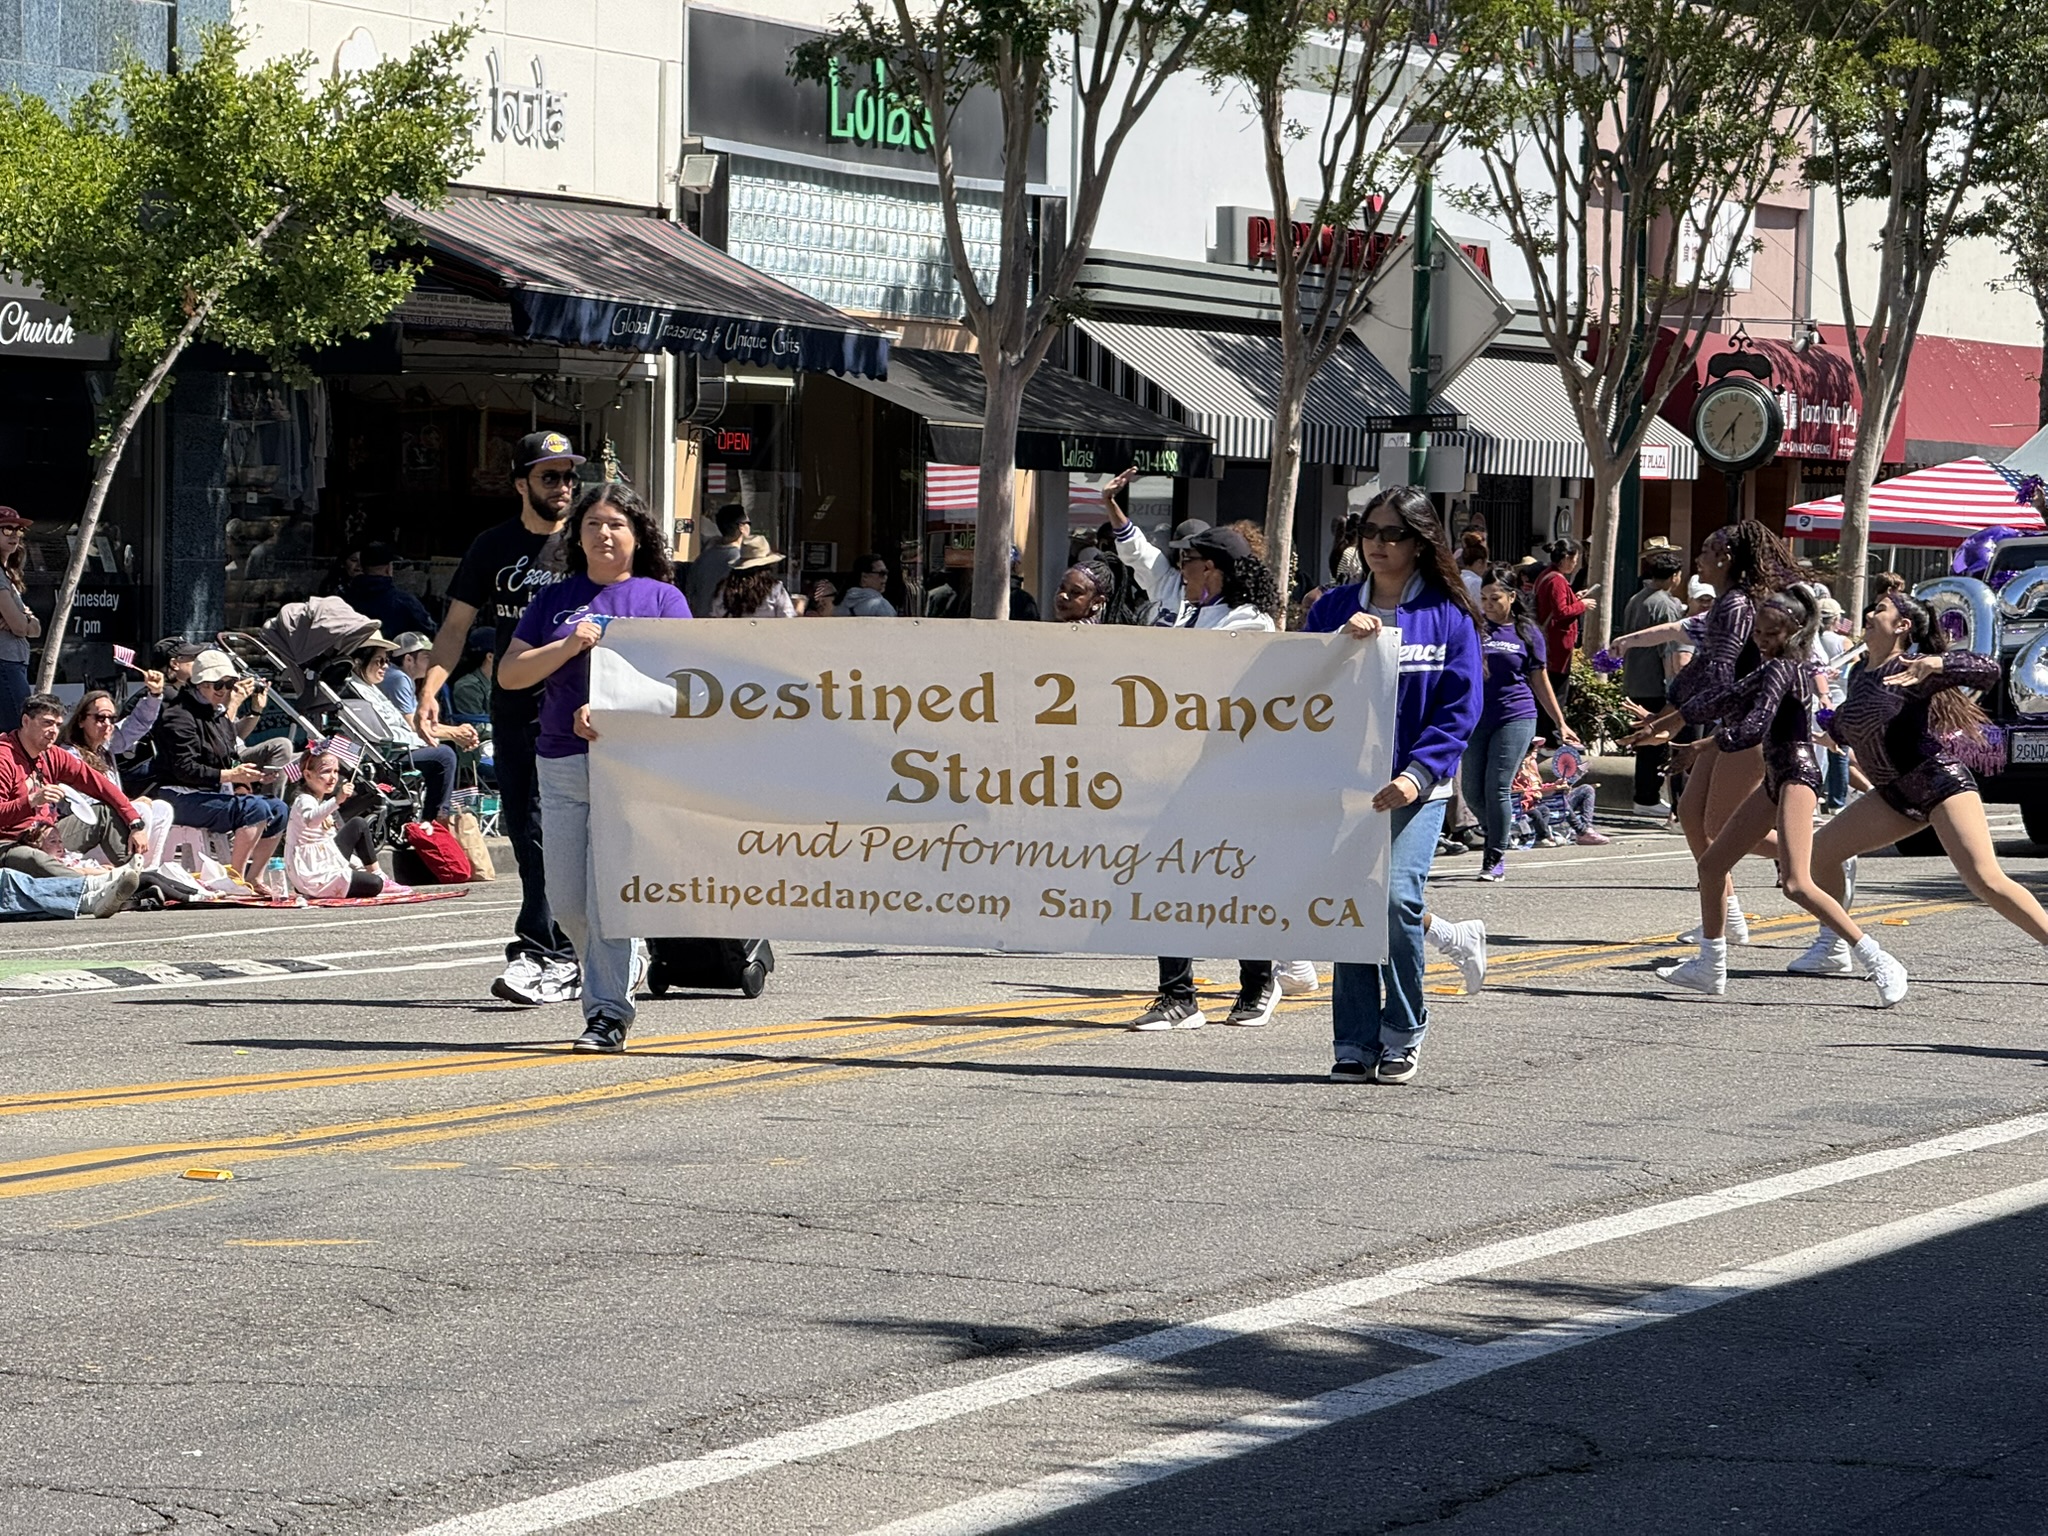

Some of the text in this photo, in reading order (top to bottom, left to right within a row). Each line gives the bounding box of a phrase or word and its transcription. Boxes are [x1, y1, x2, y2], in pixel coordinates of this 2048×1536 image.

[0, 301, 75, 345] Church
[612, 308, 800, 358] Global Treasures & Unique Gifts
[1801, 398, 1820, 430] Hong
[1821, 398, 1840, 432] Kong
[1843, 401, 1858, 433] City
[717, 431, 750, 451] OPEN
[1061, 438, 1179, 473] Lola's 521-4488
[54, 589, 120, 611] dnesday
[497, 603, 527, 619] BLAC
[74, 616, 101, 638] 7 pm
[1399, 643, 1446, 661] ence
[666, 668, 1335, 743] Destined 2 Dance
[886, 748, 1123, 810] Studio
[737, 821, 1257, 886] and Performing Arts
[620, 876, 1365, 932] destined2dance.com San Leandro, CA
